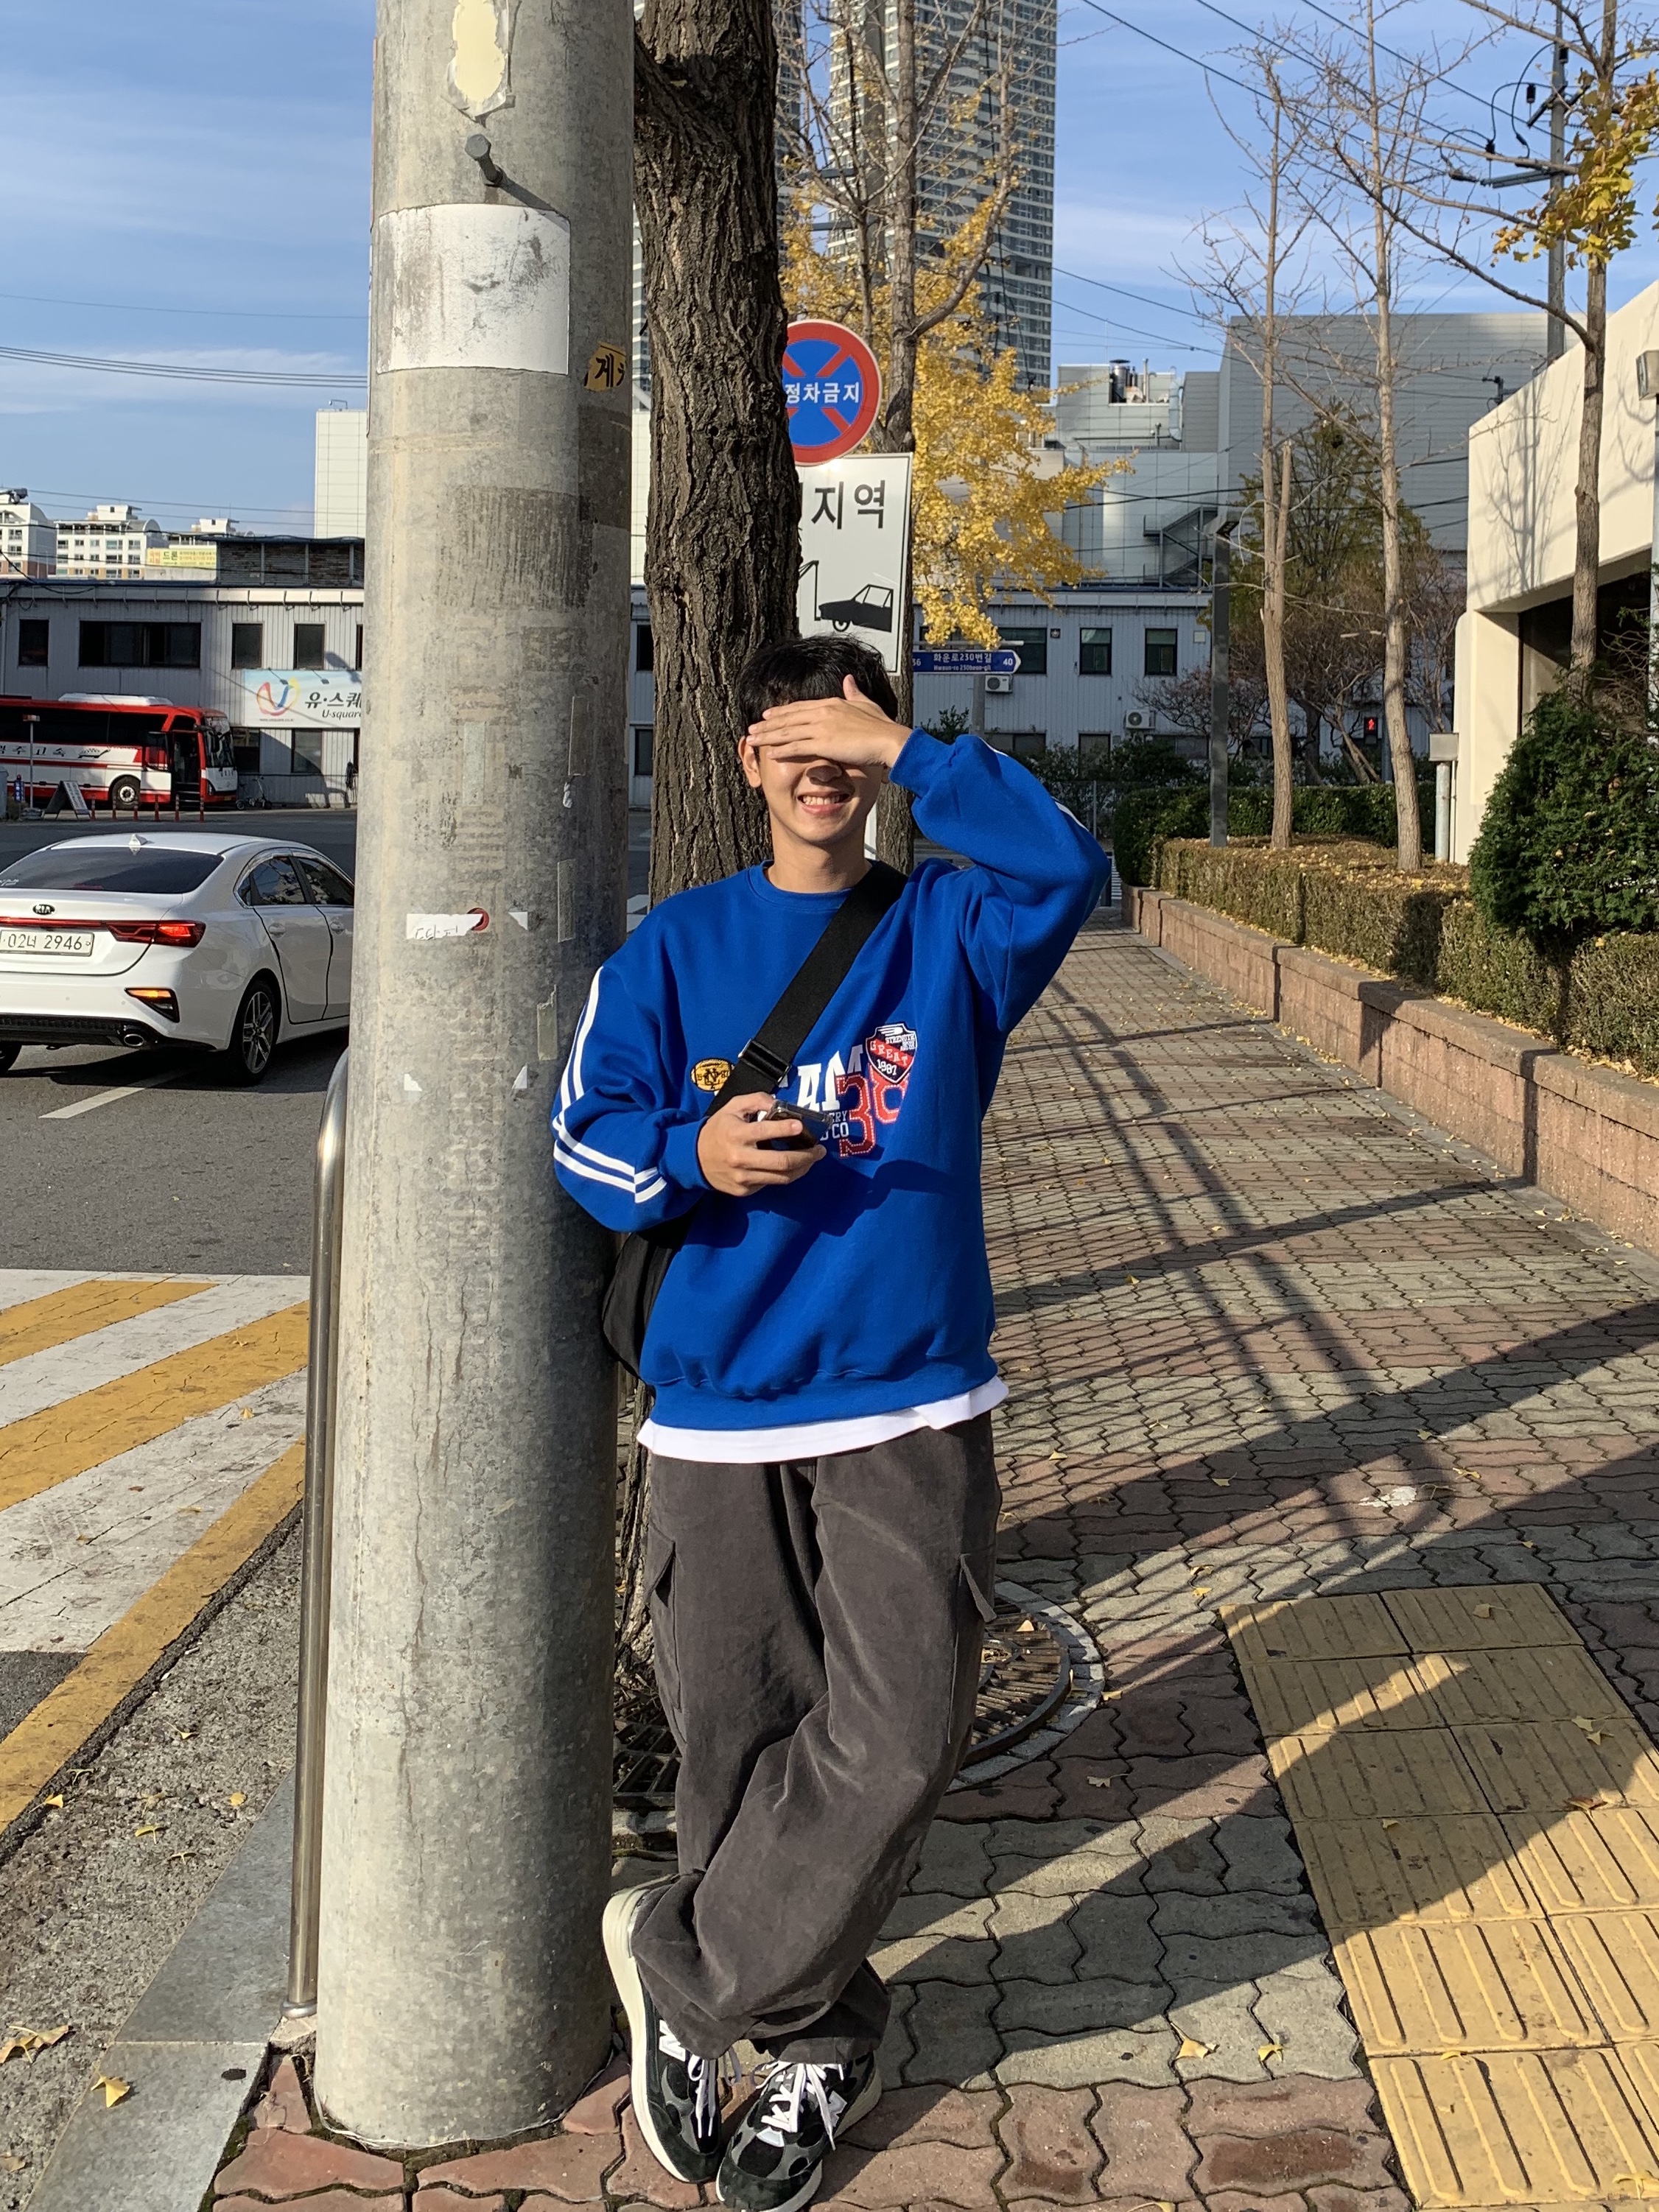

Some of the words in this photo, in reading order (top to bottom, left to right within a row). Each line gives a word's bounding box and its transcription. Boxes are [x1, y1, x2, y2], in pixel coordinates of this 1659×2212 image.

[785, 382, 860, 404] 정차금지
[799, 480, 885, 530] 지역
[933, 653, 992, 663] 화운로230번길
[1003, 658, 1014, 666] 40
[35, 905, 52, 913] KIA
[8, 933, 37, 948] 02너
[43, 934, 83, 950] 2946
[870, 1040, 908, 1067] GREAT
[877, 1059, 897, 1075] 1987
